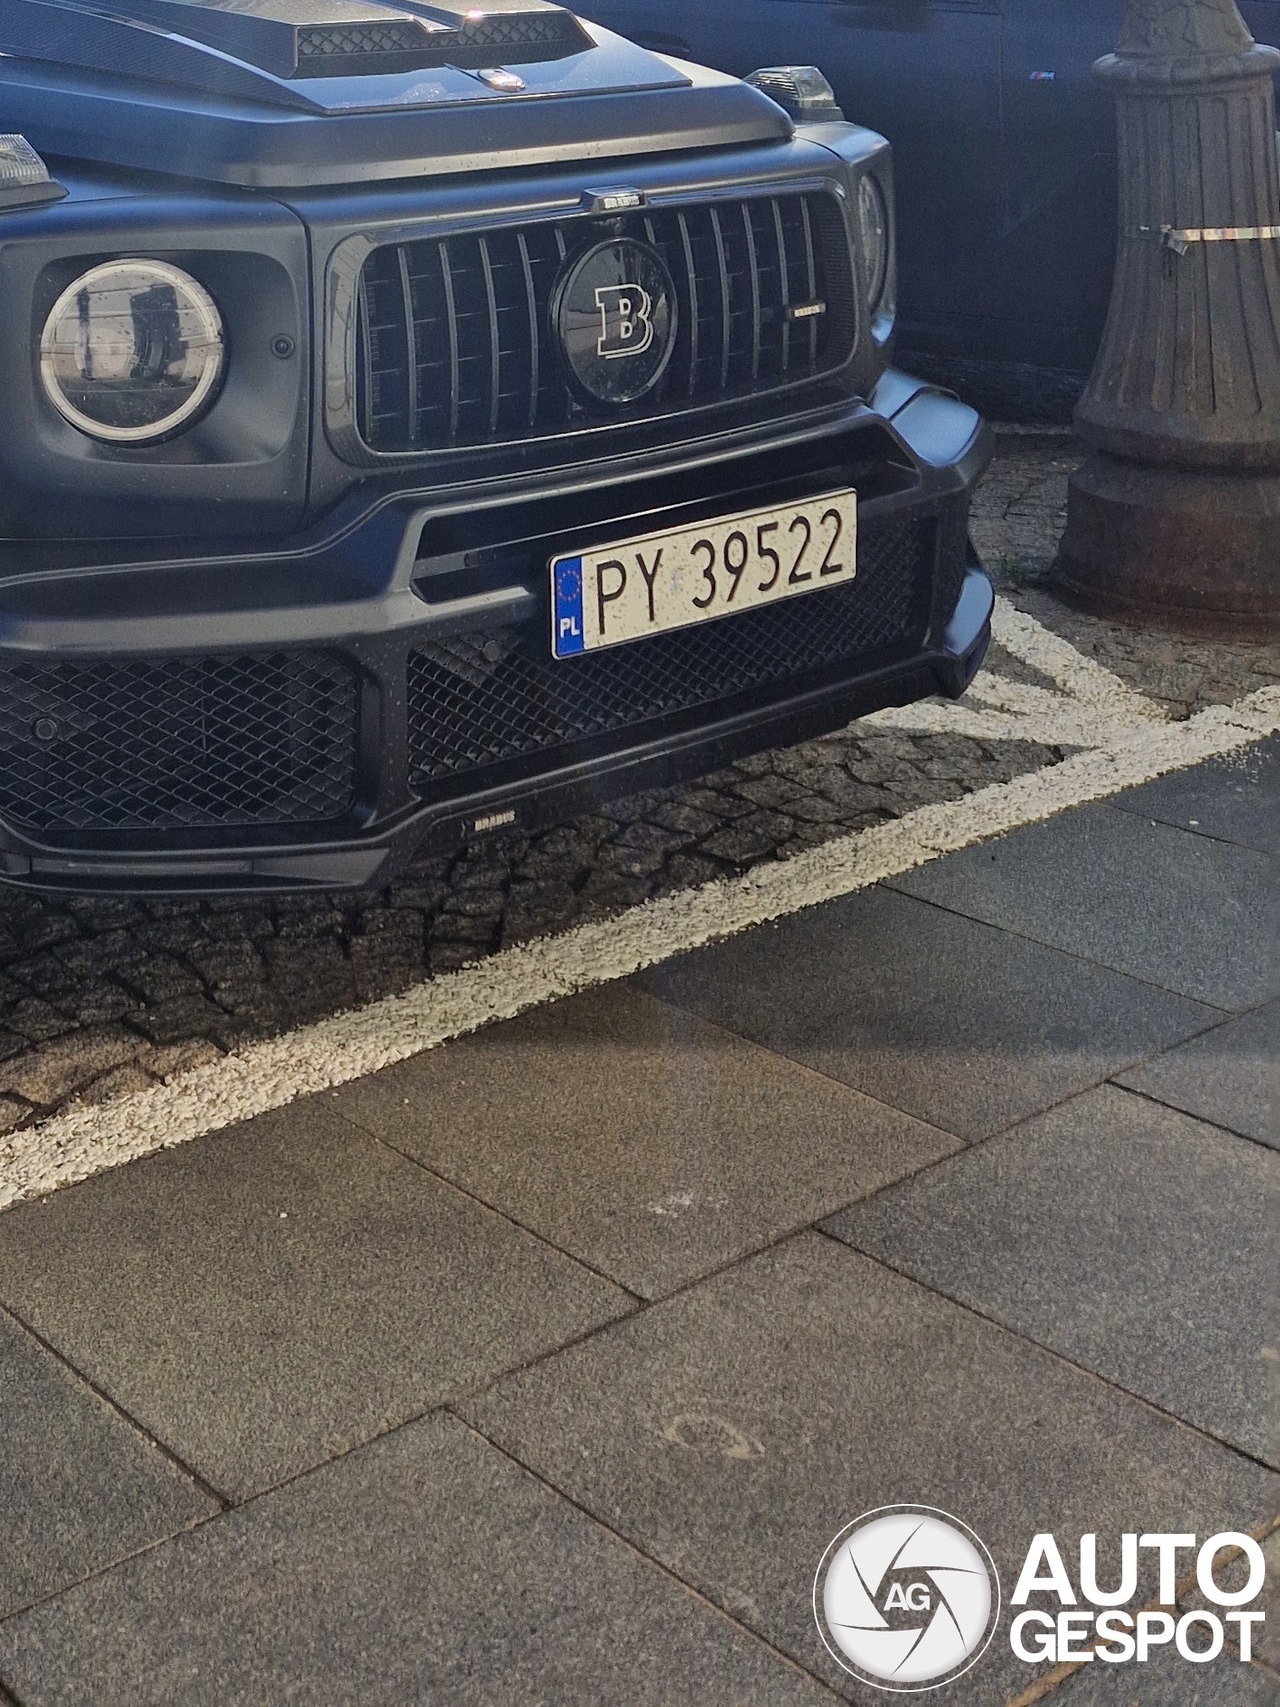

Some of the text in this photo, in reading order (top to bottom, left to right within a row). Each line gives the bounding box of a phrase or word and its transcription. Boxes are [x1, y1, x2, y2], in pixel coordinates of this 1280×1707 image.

[595, 283, 654, 360] B
[596, 508, 843, 635] PY 39522
[559, 616, 580, 638] PL
